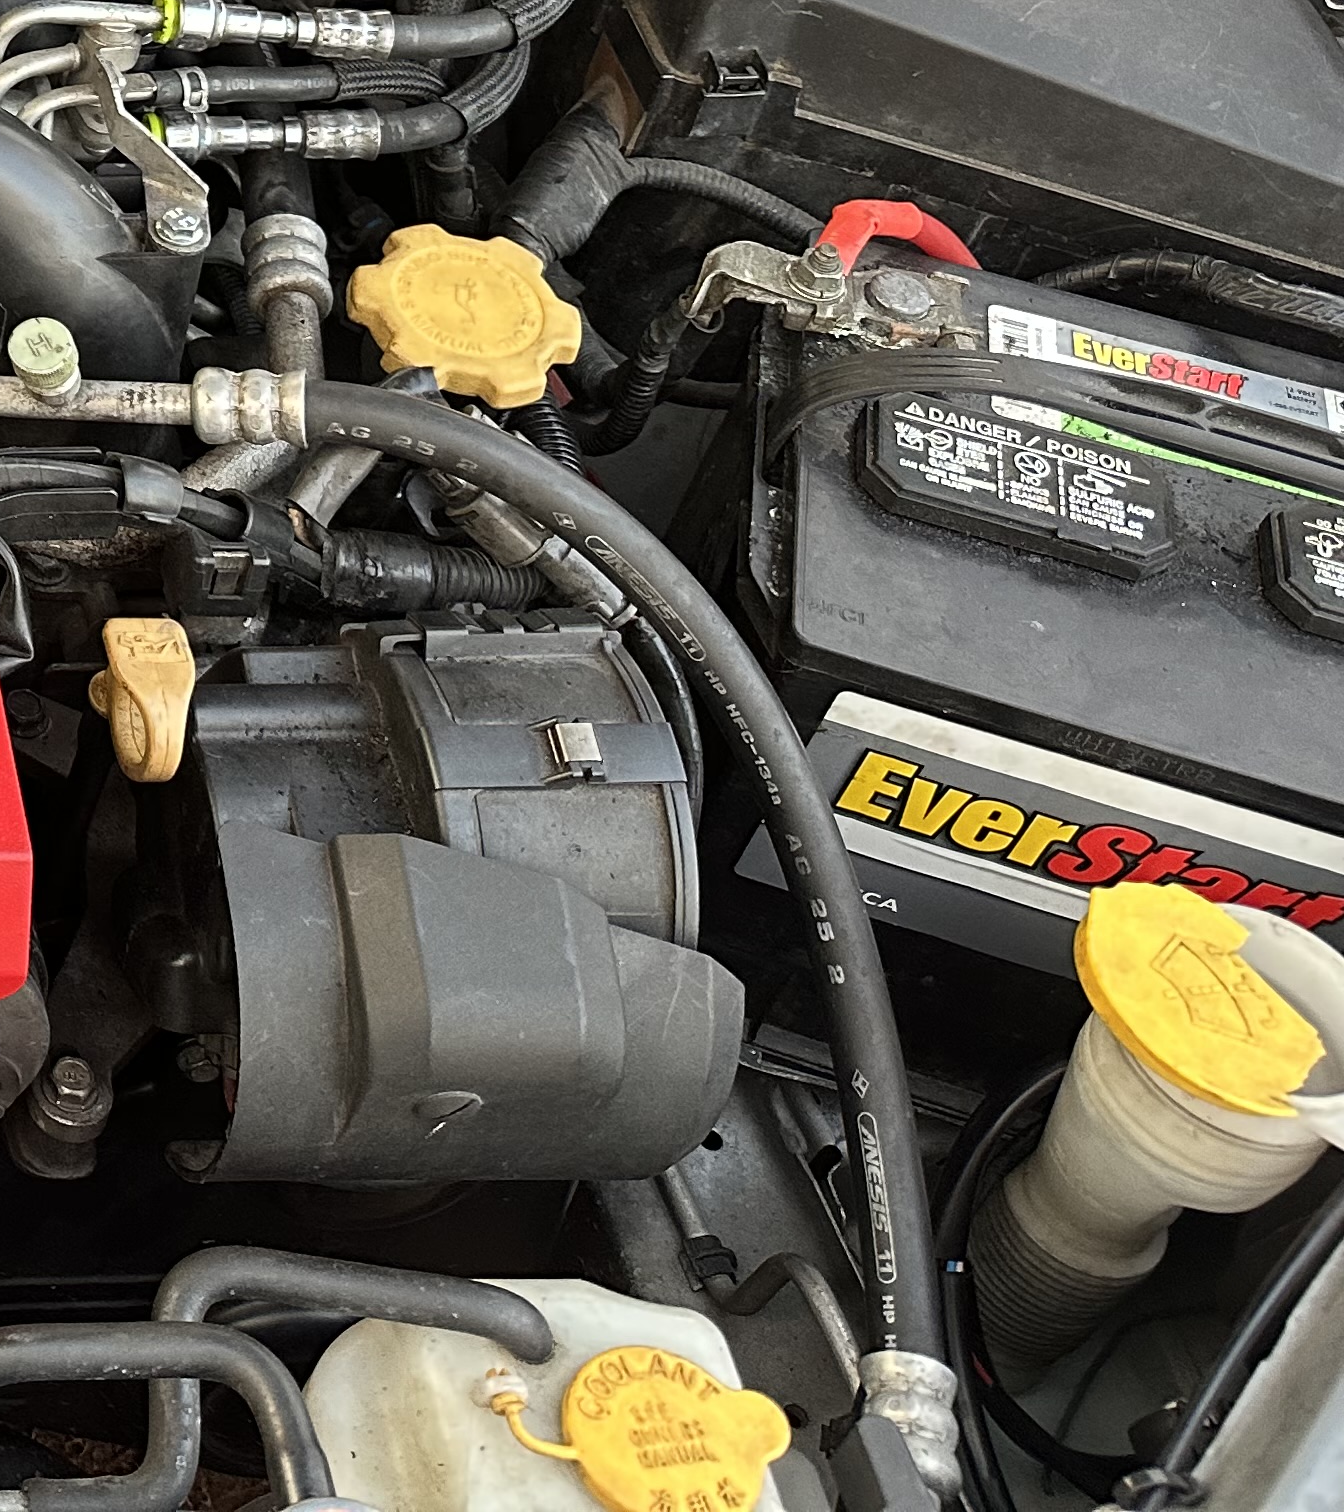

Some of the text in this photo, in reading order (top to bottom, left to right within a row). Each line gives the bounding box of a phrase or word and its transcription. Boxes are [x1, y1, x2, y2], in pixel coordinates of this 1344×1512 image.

[25, 332, 53, 357] H
[1071, 330, 1245, 400] EverStart
[392, 435, 437, 456] 25
[928, 407, 1022, 444] DANGER
[1046, 439, 1132, 475] POISON
[1020, 473, 1041, 486] NO
[1068, 486, 1125, 510] SULFURIC
[703, 669, 728, 696] HP
[725, 702, 782, 806] HFC-134a
[810, 898, 836, 942] 25
[826, 964, 846, 985] 2
[860, 889, 898, 913] CA
[877, 1248, 893, 1273] 11
[882, 1294, 896, 1324] HP
[577, 1353, 721, 1421] COOLANT
